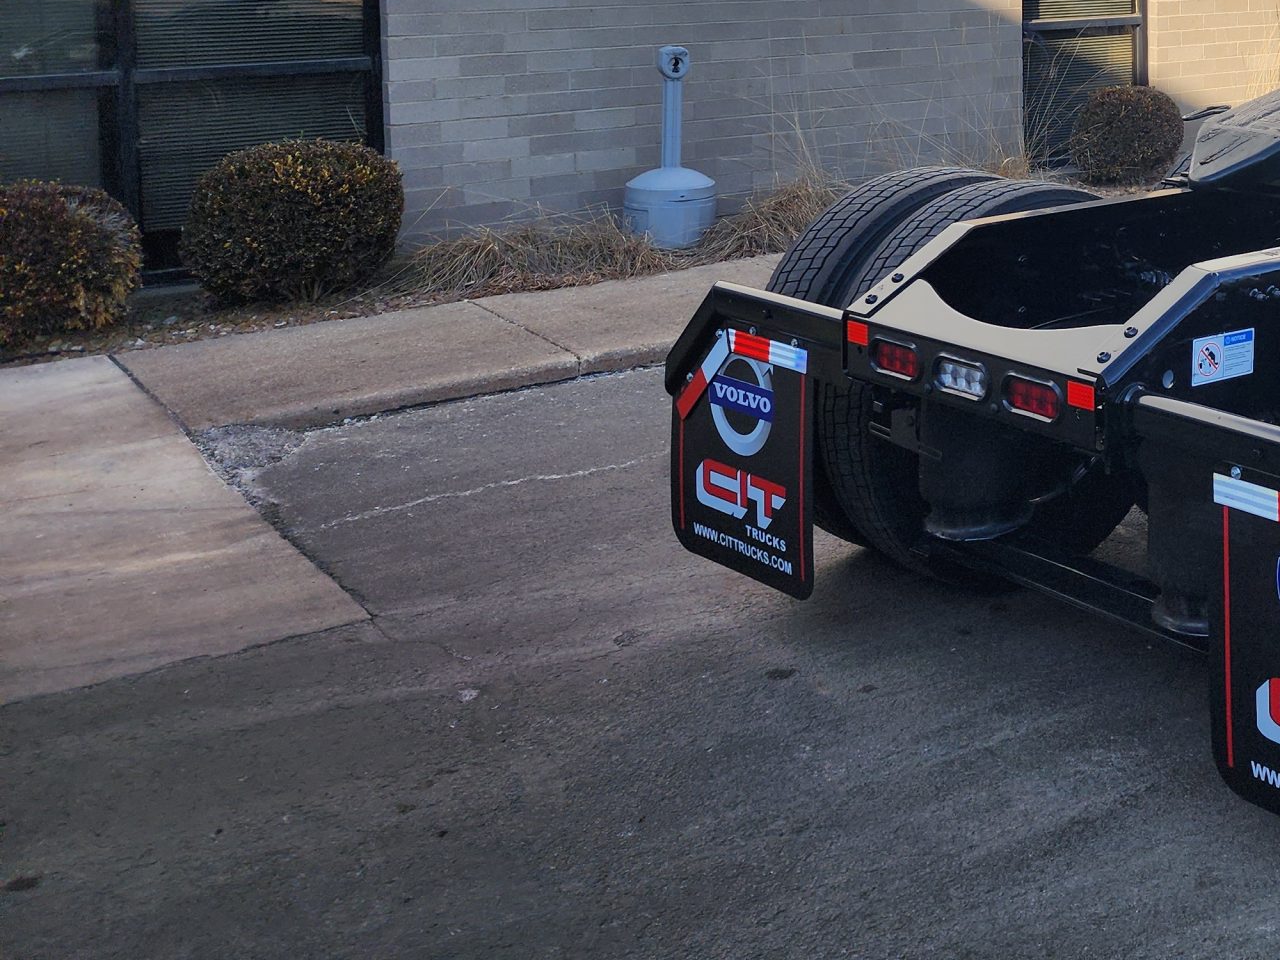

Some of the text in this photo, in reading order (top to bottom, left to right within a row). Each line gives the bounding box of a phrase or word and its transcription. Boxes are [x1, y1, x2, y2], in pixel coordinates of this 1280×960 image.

[712, 381, 772, 413] VOLVO
[695, 458, 787, 530] CIT
[693, 521, 793, 576] WWW.CITTRUCKS.COM
[745, 524, 787, 552] TRUCKS
